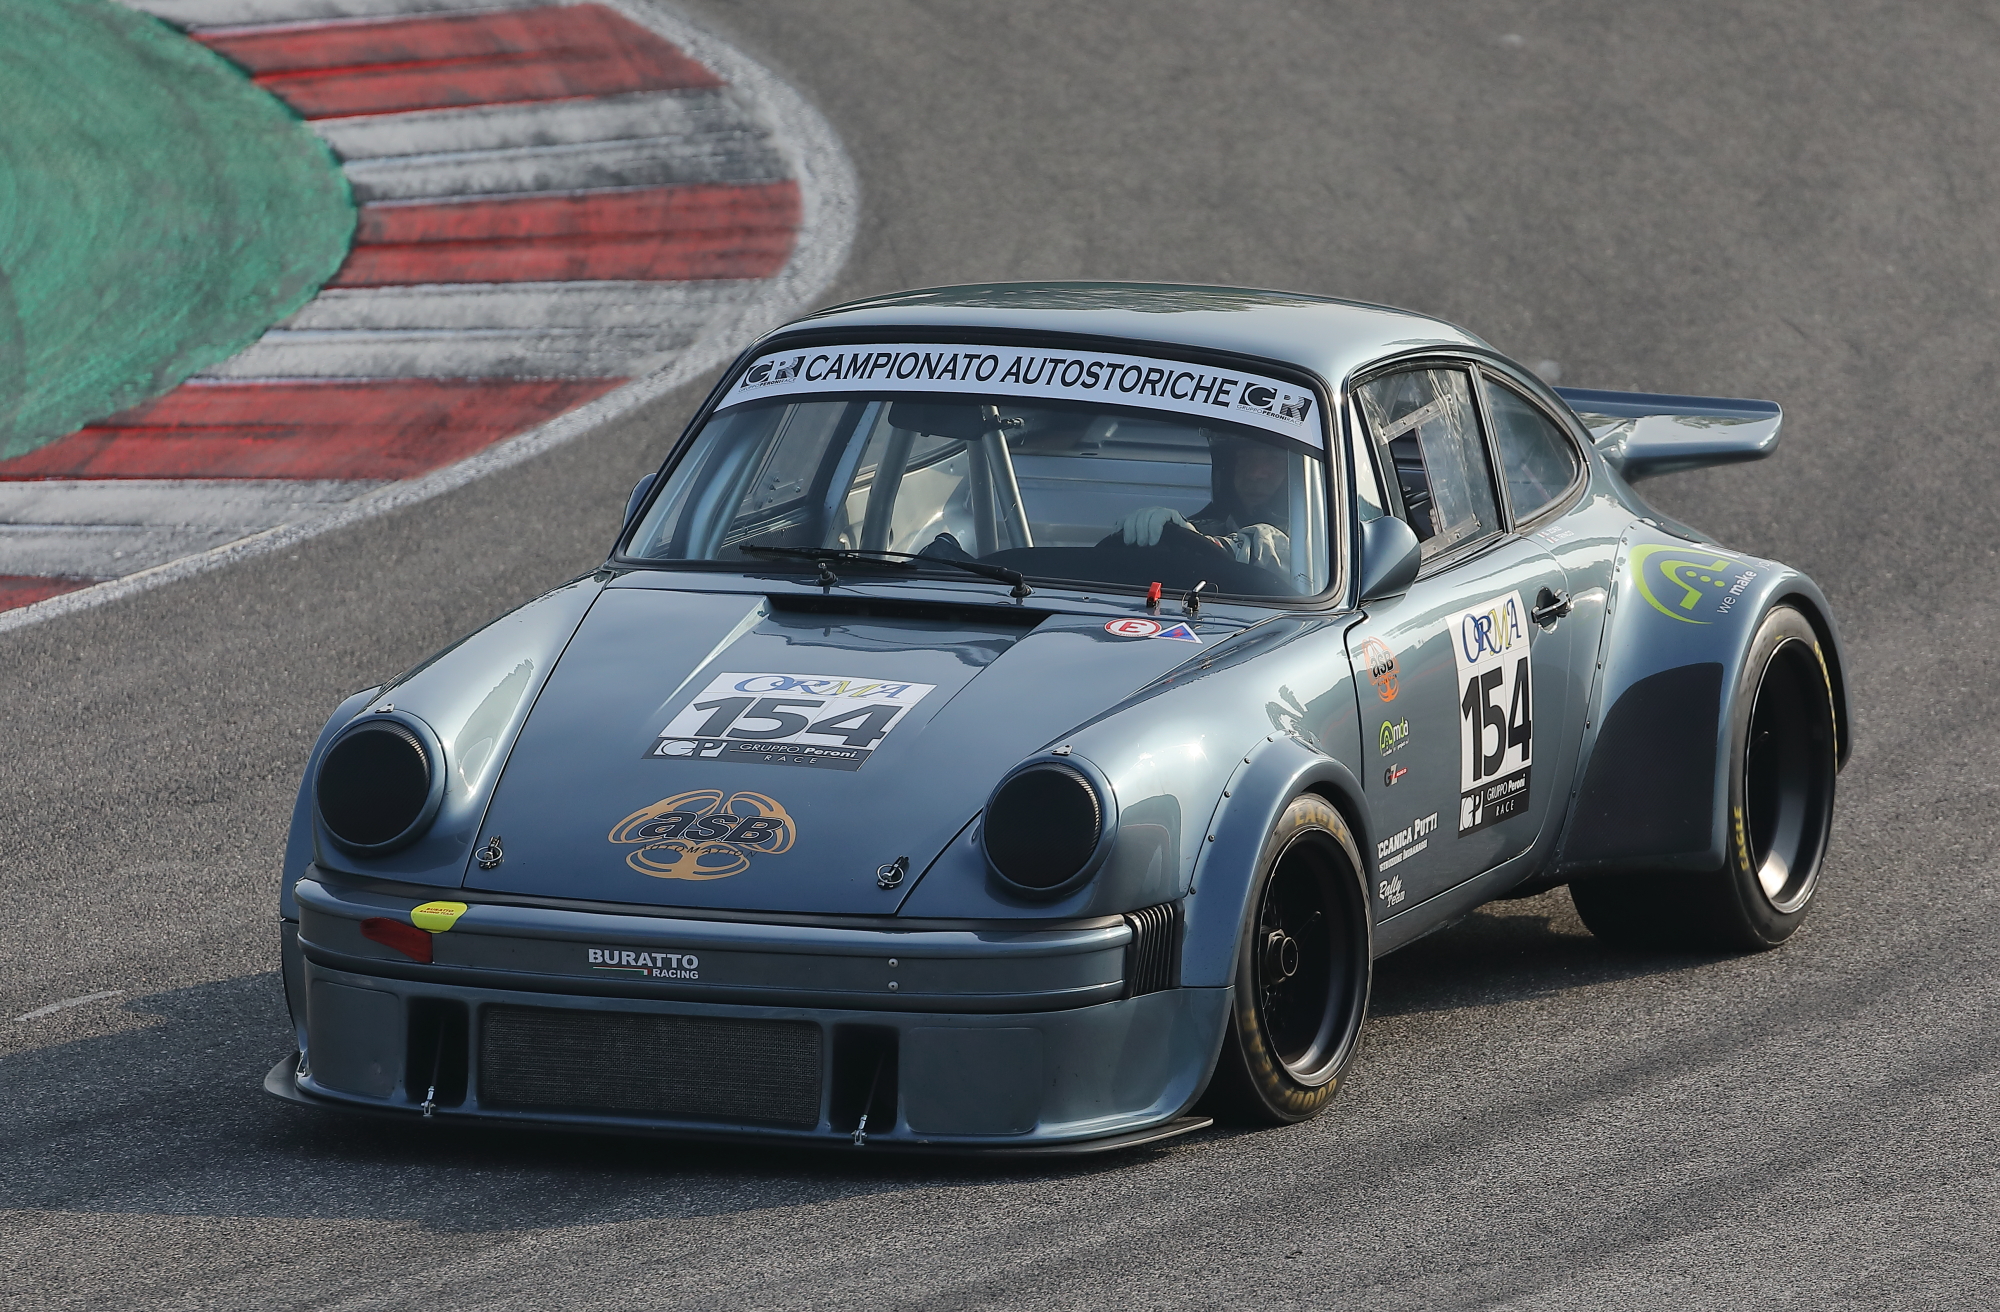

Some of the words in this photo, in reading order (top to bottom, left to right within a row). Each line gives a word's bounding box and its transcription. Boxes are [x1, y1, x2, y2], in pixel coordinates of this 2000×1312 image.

[805, 351, 998, 382] CAMPIONATO
[1000, 356, 1240, 408] AUTOSTORICHE
[1717, 596, 1736, 614] we
[1729, 569, 1757, 596] make
[1118, 621, 1147, 633] E
[1462, 597, 1522, 664] ORMA
[734, 675, 912, 699] ORMA
[692, 696, 904, 748] 154
[1461, 656, 1532, 783] 154
[739, 743, 800, 754] GRUPPO
[804, 747, 857, 758] Peroni
[763, 754, 819, 764] RACE
[1487, 782, 1507, 801] GRUPPO
[1508, 773, 1526, 793] Peroni
[1495, 799, 1515, 817] RACE
[1294, 803, 1346, 844] EAGLE
[1378, 826, 1412, 860] CCANICA
[1733, 805, 1749, 872] EAGLE
[1379, 874, 1403, 900] Rally
[588, 948, 699, 970] BURATTO
[652, 968, 699, 980] RACING
